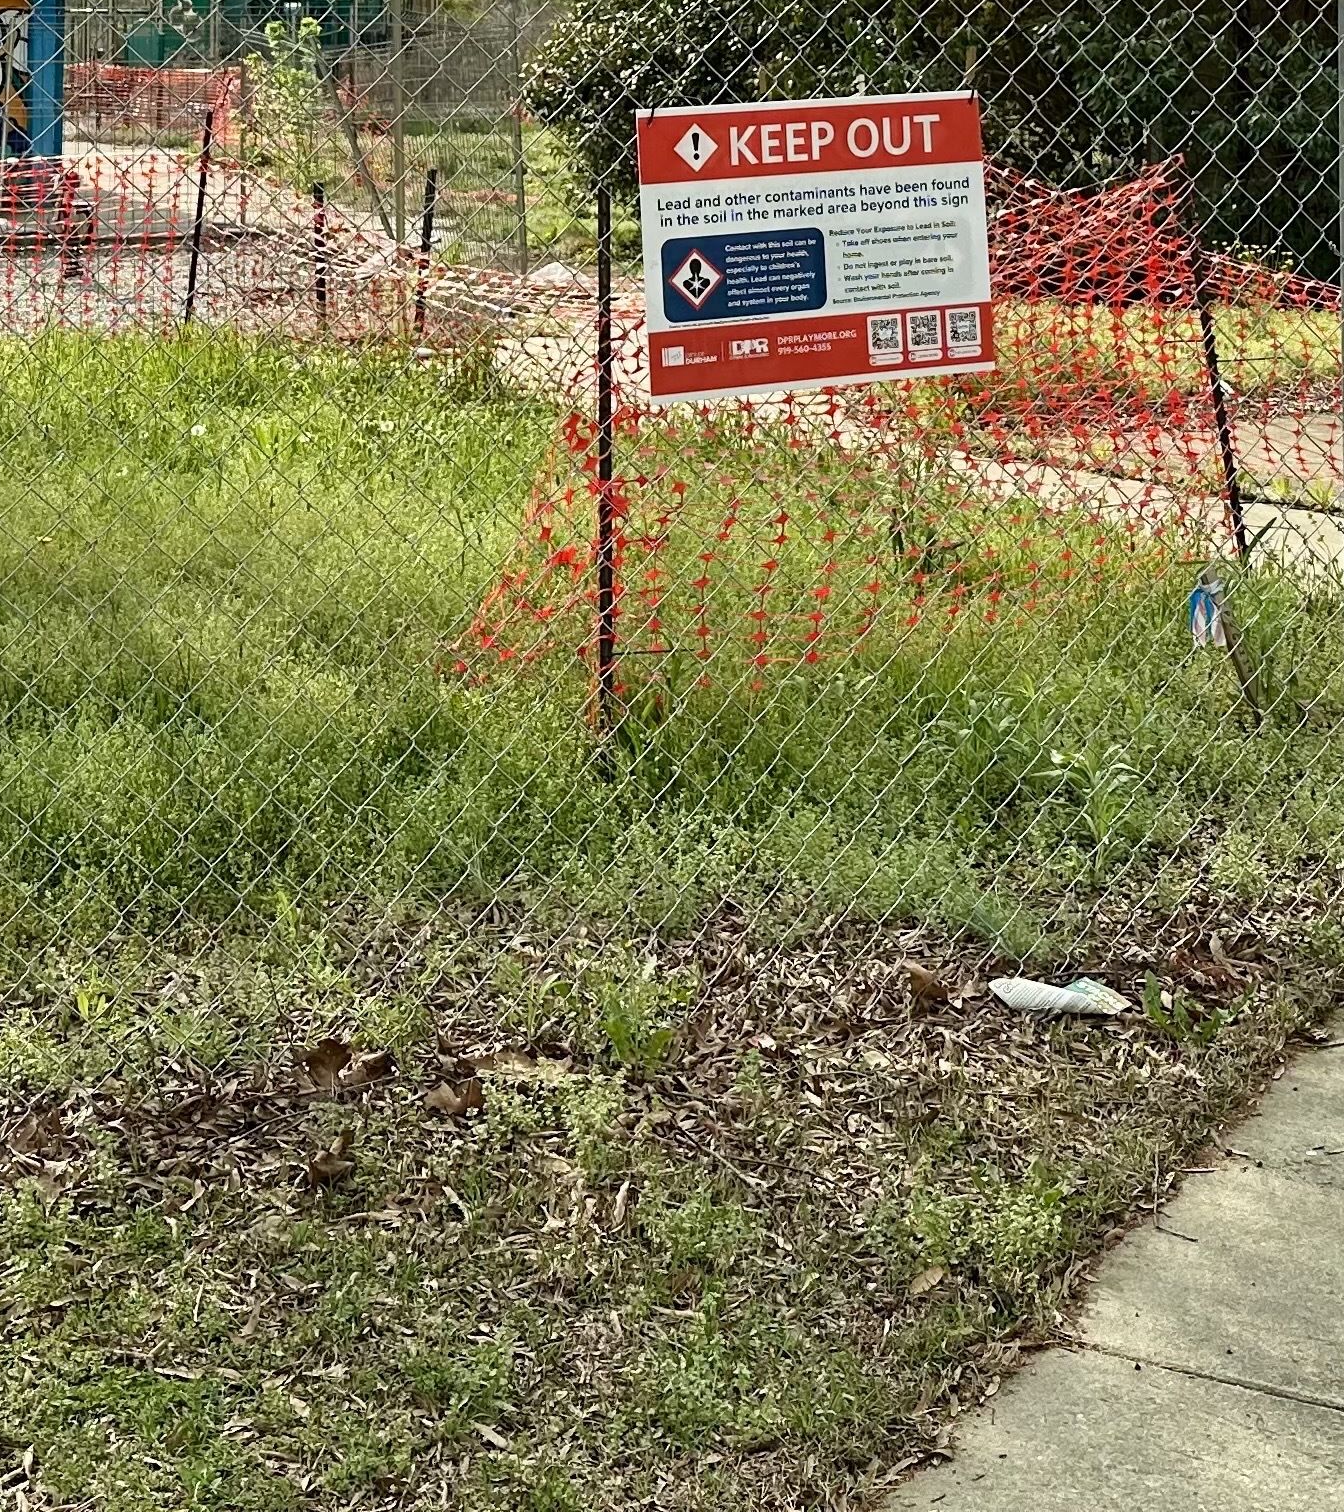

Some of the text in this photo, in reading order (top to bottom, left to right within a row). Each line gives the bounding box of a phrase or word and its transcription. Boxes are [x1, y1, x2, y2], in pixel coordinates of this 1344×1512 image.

[728, 114, 941, 166] KEEP OUT
[657, 179, 969, 211] Lead and other contaminants have been found
[660, 193, 968, 227] in the soil in the marked area beyond this sign
[874, 225, 905, 233] Exposure
[725, 244, 751, 252] Contact
[726, 255, 761, 263] dangerous
[770, 253, 786, 261] your
[868, 260, 889, 269] ingest
[726, 266, 759, 274] especially
[921, 267, 945, 275] coming
[782, 271, 815, 280] negatively
[845, 285, 871, 293] contact
[742, 297, 766, 306] system
[775, 296, 789, 304] your
[777, 329, 857, 345] DPRPLAYMORE.ORG
[732, 338, 769, 356] DPR
[686, 355, 718, 365] DURHAM
